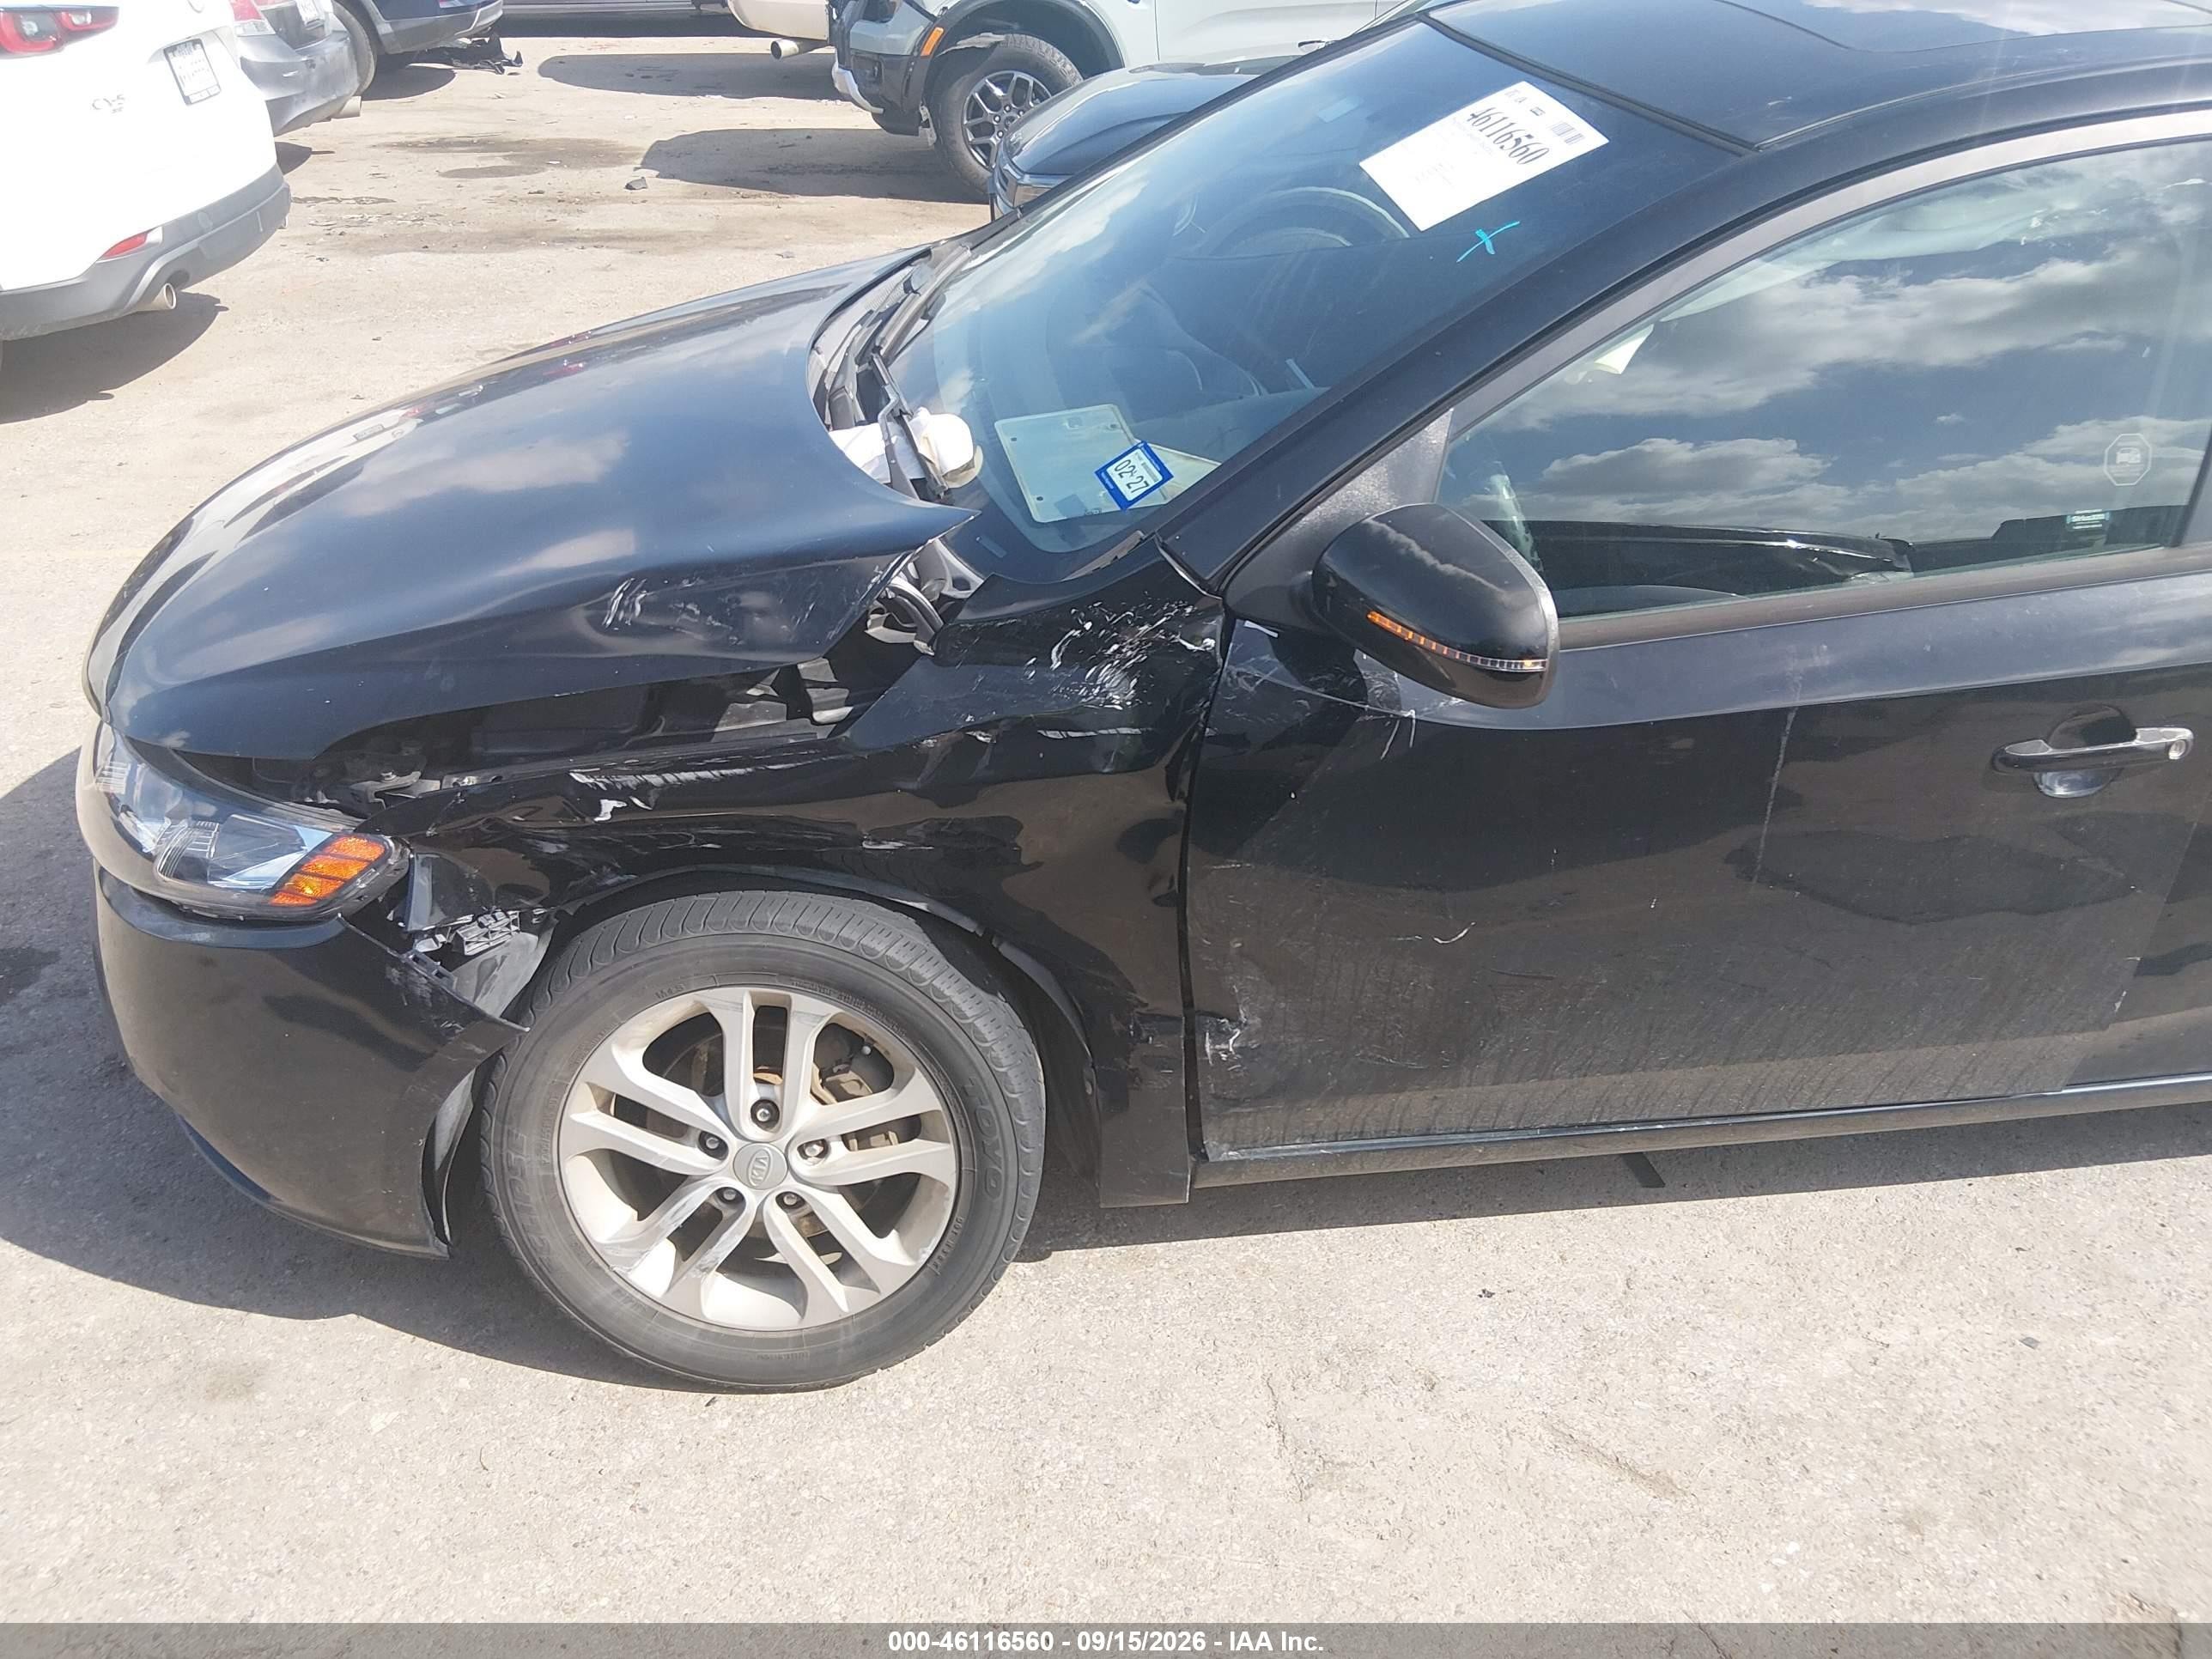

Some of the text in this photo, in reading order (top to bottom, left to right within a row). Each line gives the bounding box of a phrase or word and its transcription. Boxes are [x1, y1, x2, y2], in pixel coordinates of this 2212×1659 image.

[1467, 106, 1549, 165] 46116560
[963, 1077, 1004, 1200] TOYO
[750, 1155, 769, 1182] KIA
